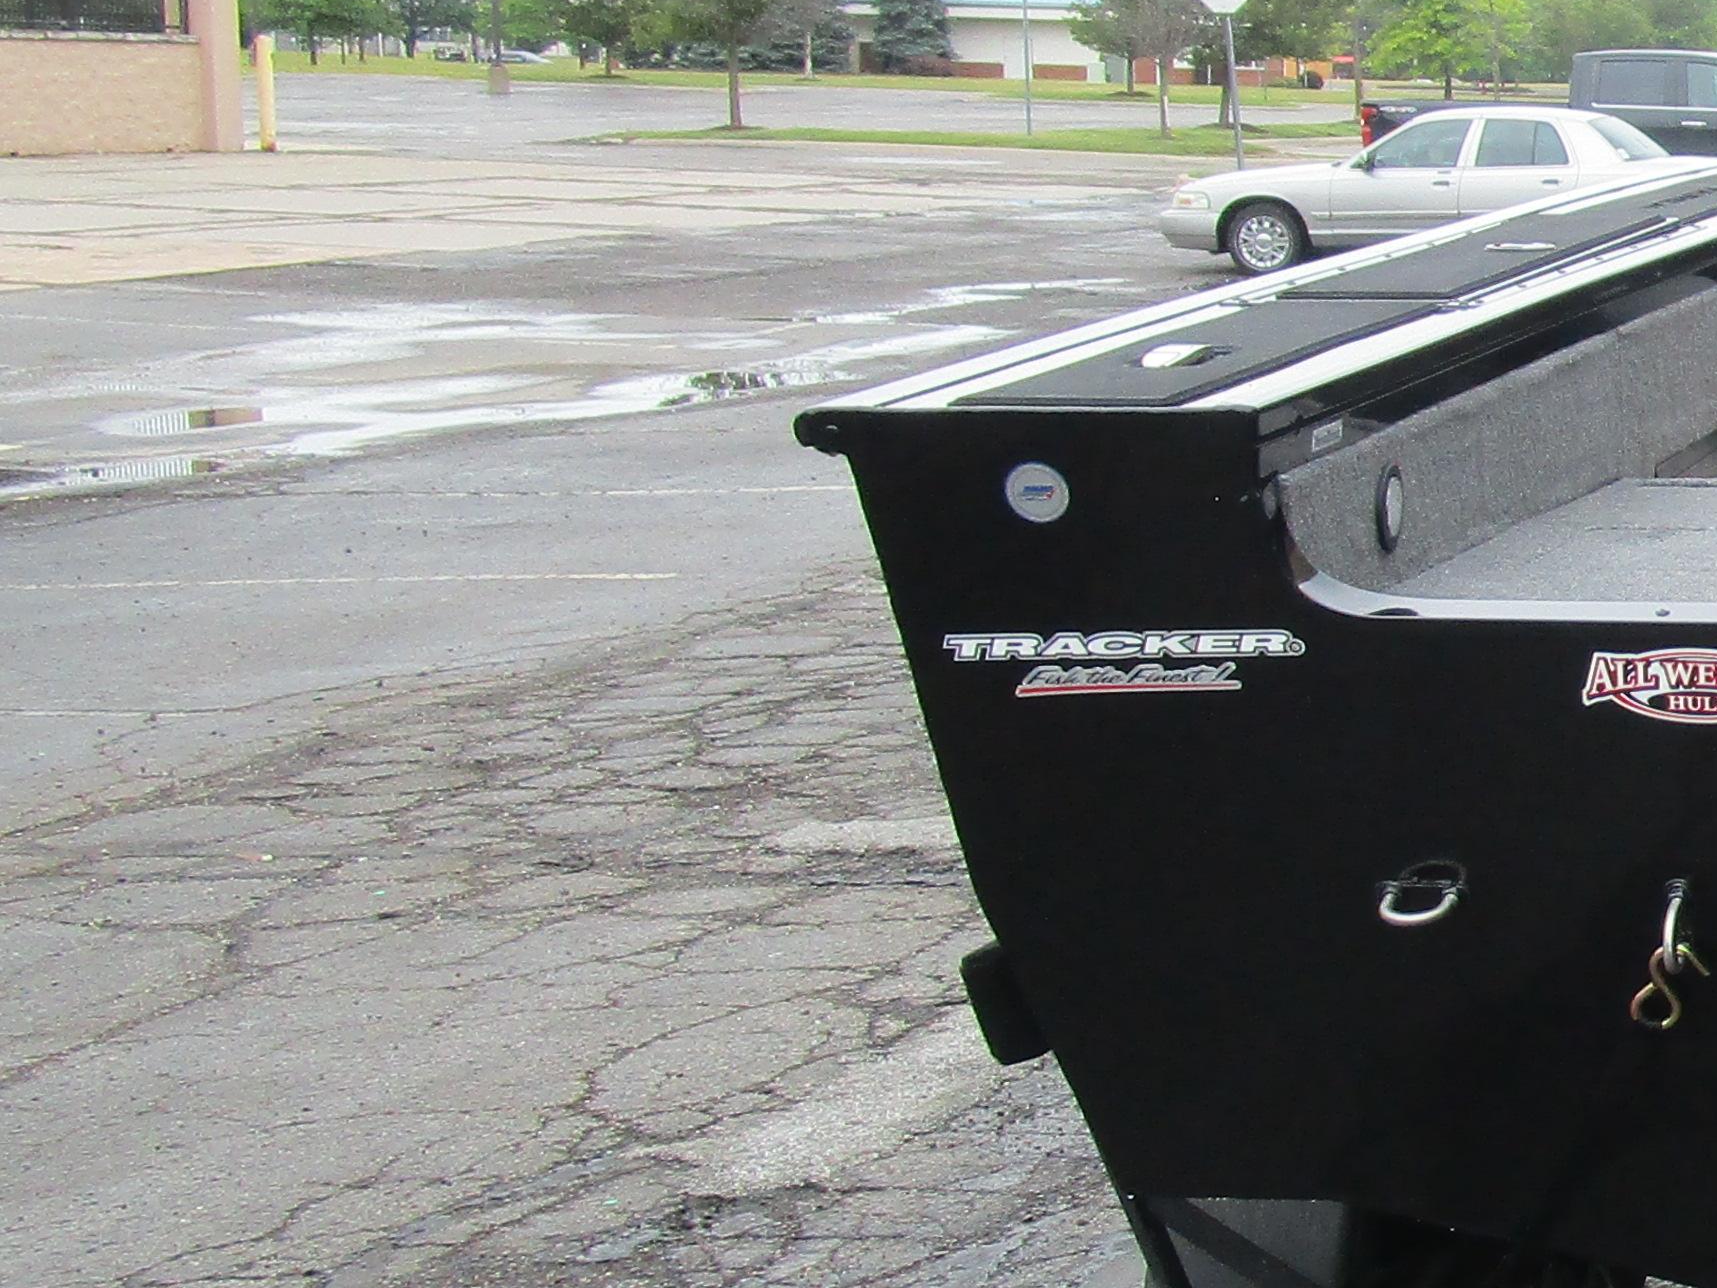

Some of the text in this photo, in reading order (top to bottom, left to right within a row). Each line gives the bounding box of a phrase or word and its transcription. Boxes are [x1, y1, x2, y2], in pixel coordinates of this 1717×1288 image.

[1027, 666, 1081, 686] Fish
[1083, 667, 1124, 686] the
[1587, 656, 1660, 698] ALL
